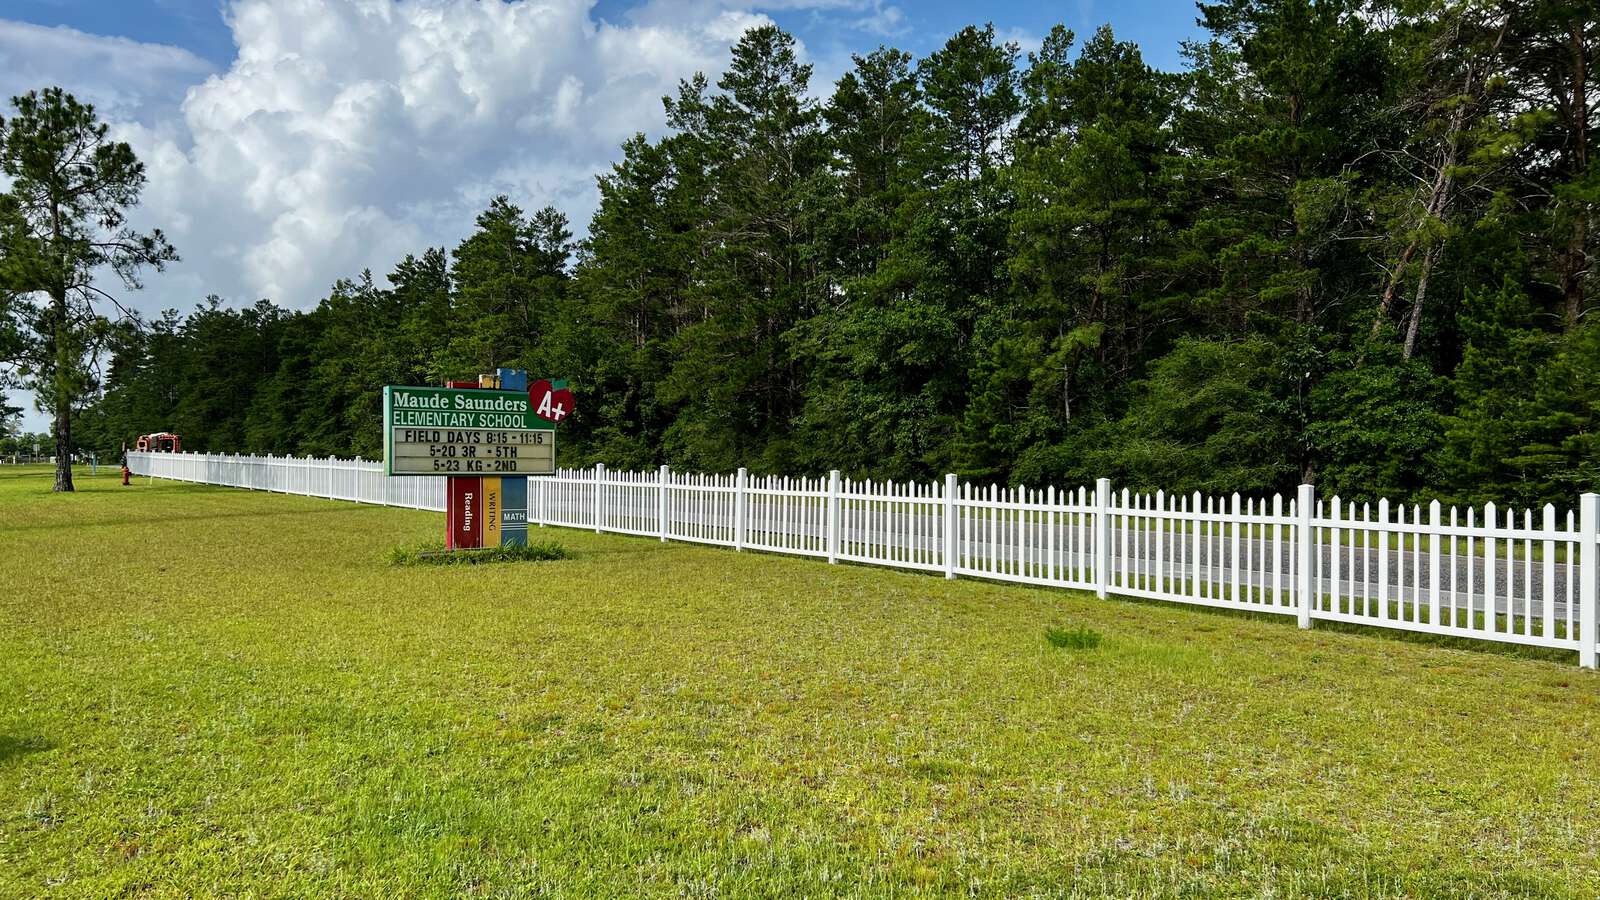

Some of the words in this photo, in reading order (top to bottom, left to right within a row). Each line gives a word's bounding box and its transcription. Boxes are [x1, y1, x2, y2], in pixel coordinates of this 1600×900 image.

[393, 392, 449, 408] Maude
[454, 394, 527, 412] Saunders
[393, 411, 475, 427] ELEMENTARY
[479, 414, 527, 428] SCHOOL
[405, 430, 441, 443] FIELD
[447, 431, 481, 444] DAYS
[519, 433, 543, 444] 11:15
[430, 445, 455, 457] 5-20
[496, 447, 517, 458] 5TH
[433, 460, 460, 471] 5-23
[467, 460, 483, 471] KG
[495, 460, 517, 471] 2ND
[463, 492, 473, 532] Reading
[488, 492, 497, 531] WRITING
[503, 513, 526, 521] MATH
